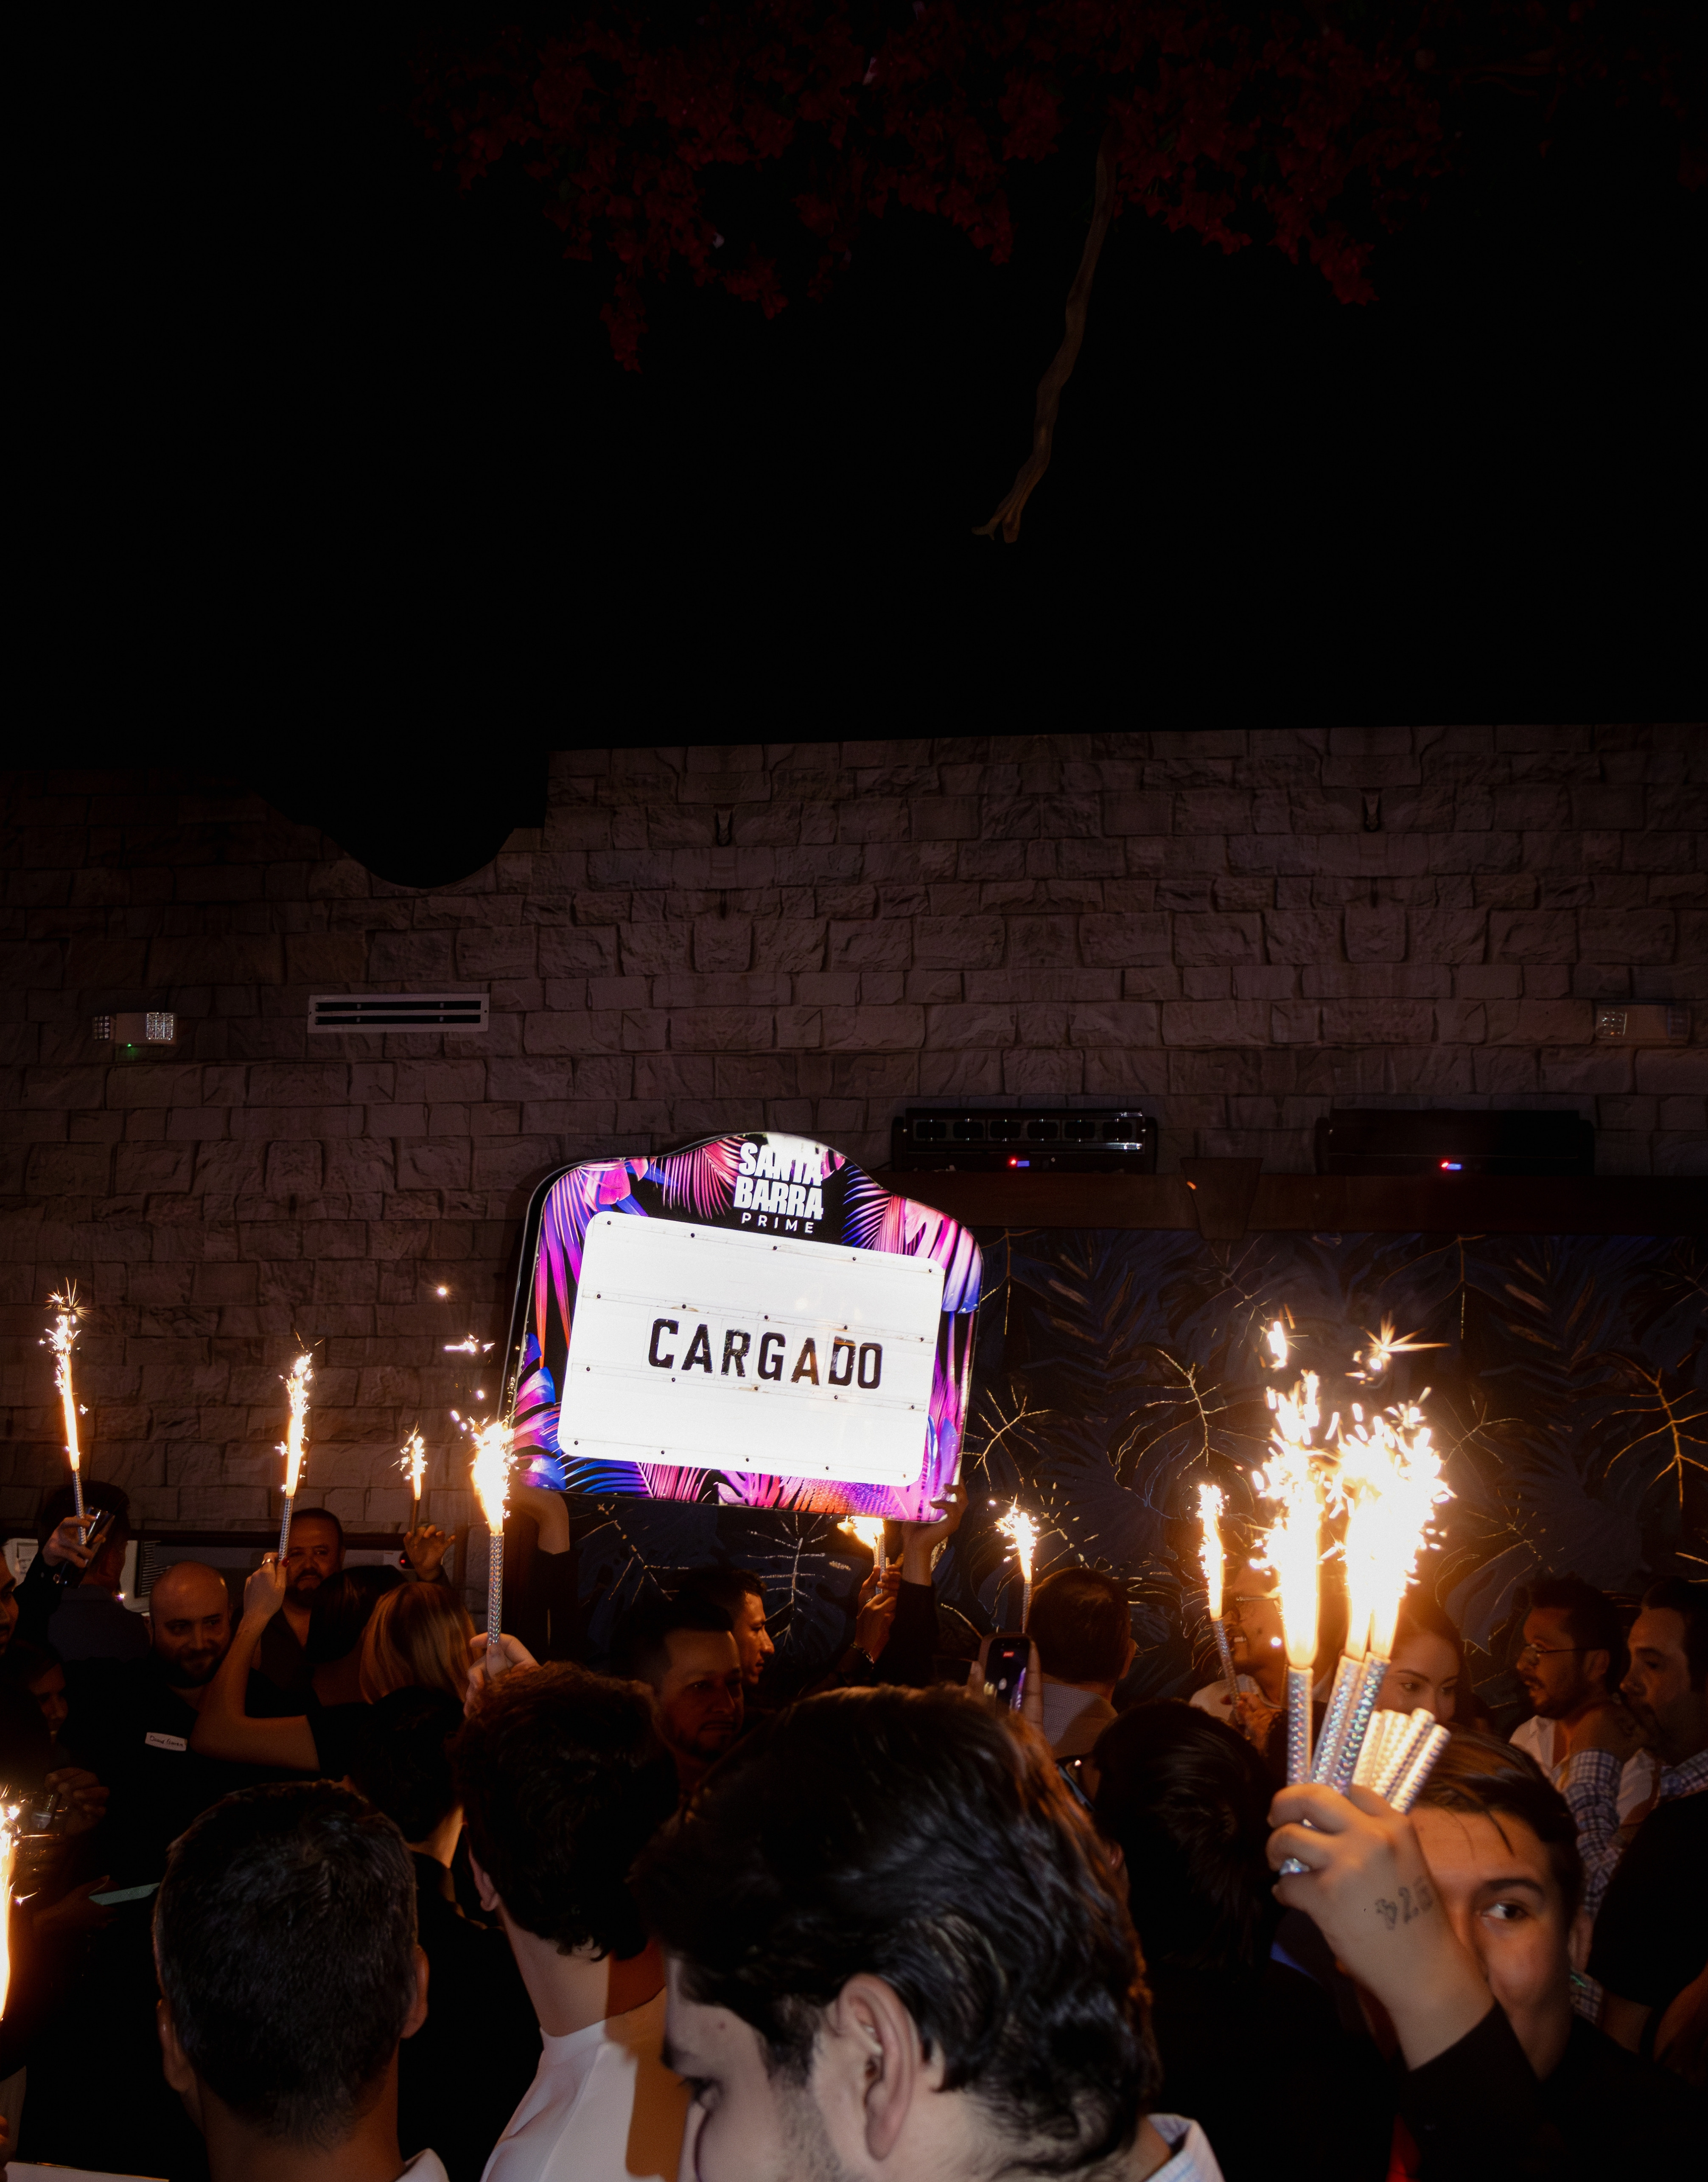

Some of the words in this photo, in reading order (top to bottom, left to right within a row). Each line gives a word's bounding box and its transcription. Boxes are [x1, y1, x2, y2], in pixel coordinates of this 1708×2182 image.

[738, 1142, 823, 1186] SANTA
[734, 1175, 824, 1220] BARRA
[742, 1212, 814, 1234] PRIME
[648, 1318, 883, 1389] CARGADO
